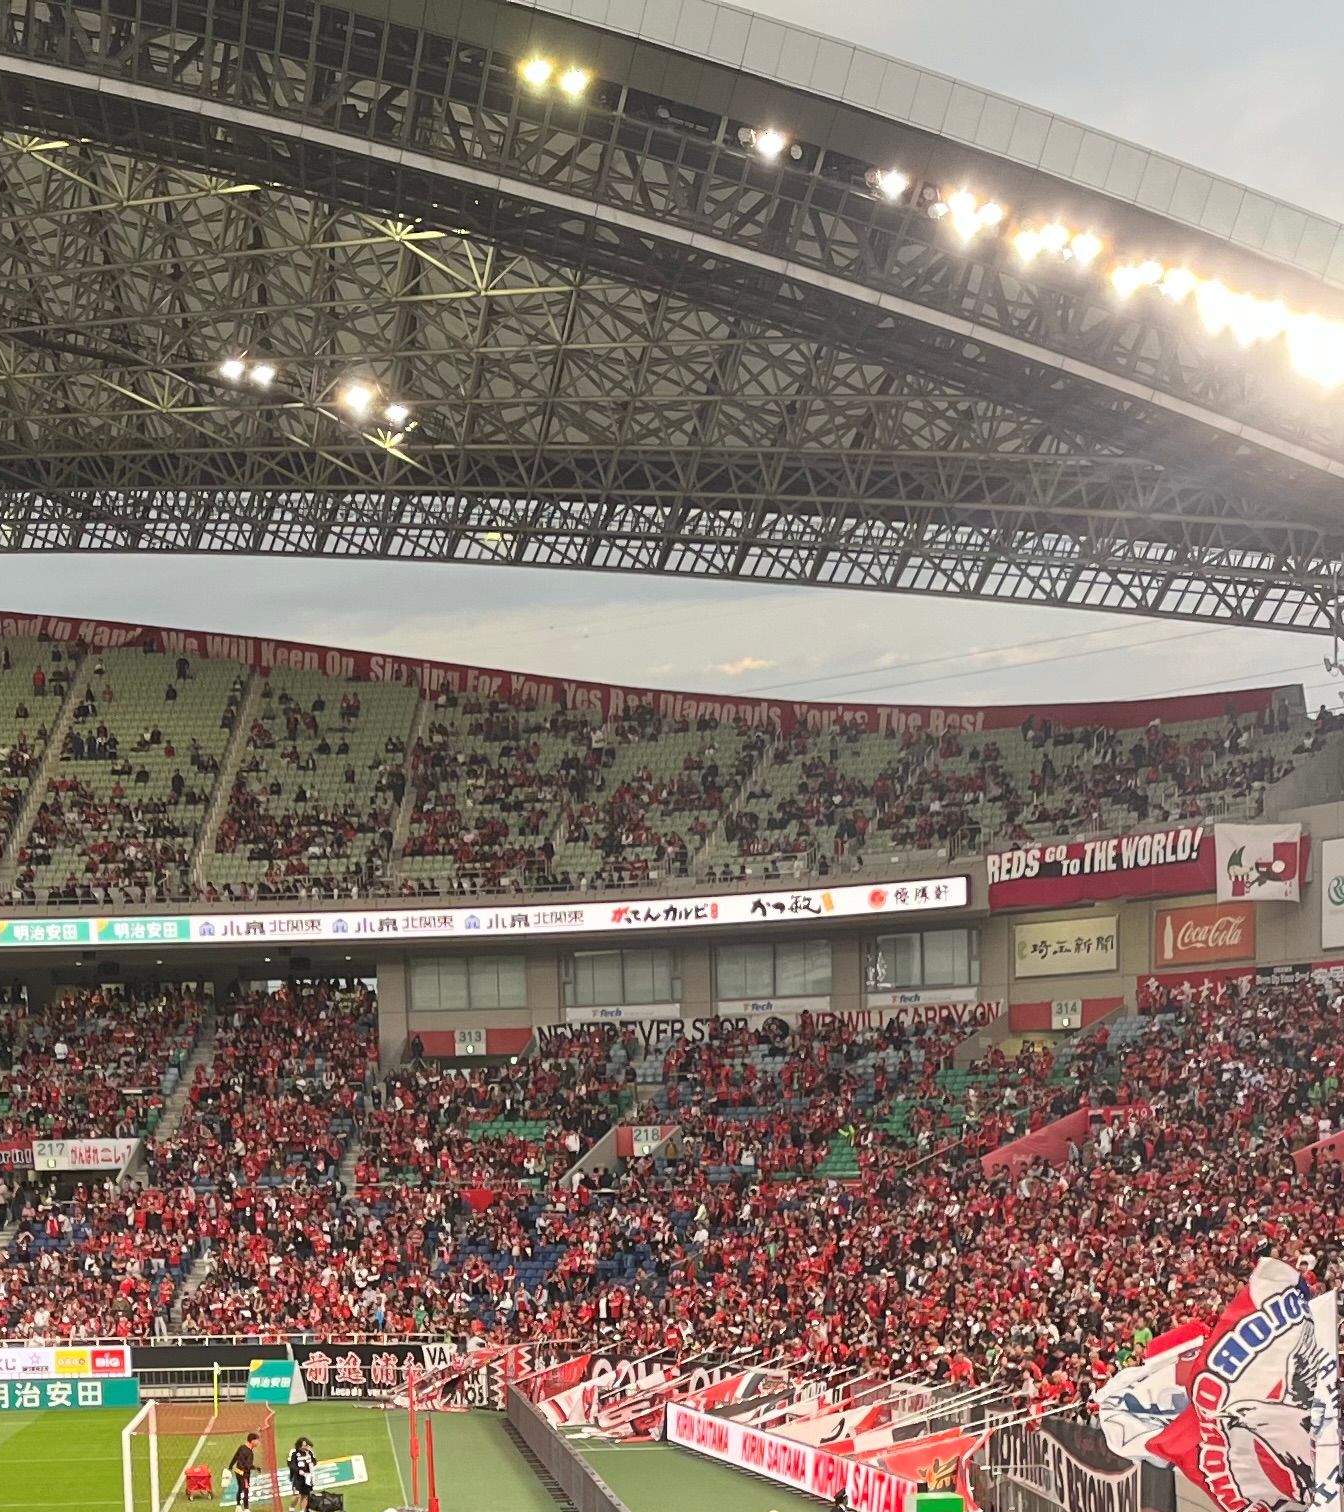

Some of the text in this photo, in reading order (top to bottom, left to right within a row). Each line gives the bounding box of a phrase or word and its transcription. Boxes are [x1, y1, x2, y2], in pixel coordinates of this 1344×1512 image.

[162, 630, 199, 657] We
[205, 635, 254, 664] Will
[370, 655, 456, 693] Sining
[988, 827, 1204, 884] REDS GO TO THE WORLD!
[13, 924, 77, 941] 明治安田
[114, 922, 178, 939] 明治安田
[1177, 915, 1246, 951] Coca-Cola
[1056, 1001, 1080, 1015] 314
[459, 1030, 482, 1043] 313
[633, 1127, 662, 1142] 218
[37, 1141, 65, 1156] 217
[249, 1376, 291, 1389] 明治安田
[676, 1410, 729, 1452] KIRIN SAITAMA
[741, 1431, 806, 1484] KIRIN SAITAMA
[811, 1451, 849, 1496] KIRIN
[1052, 1442, 1065, 1504] IS
